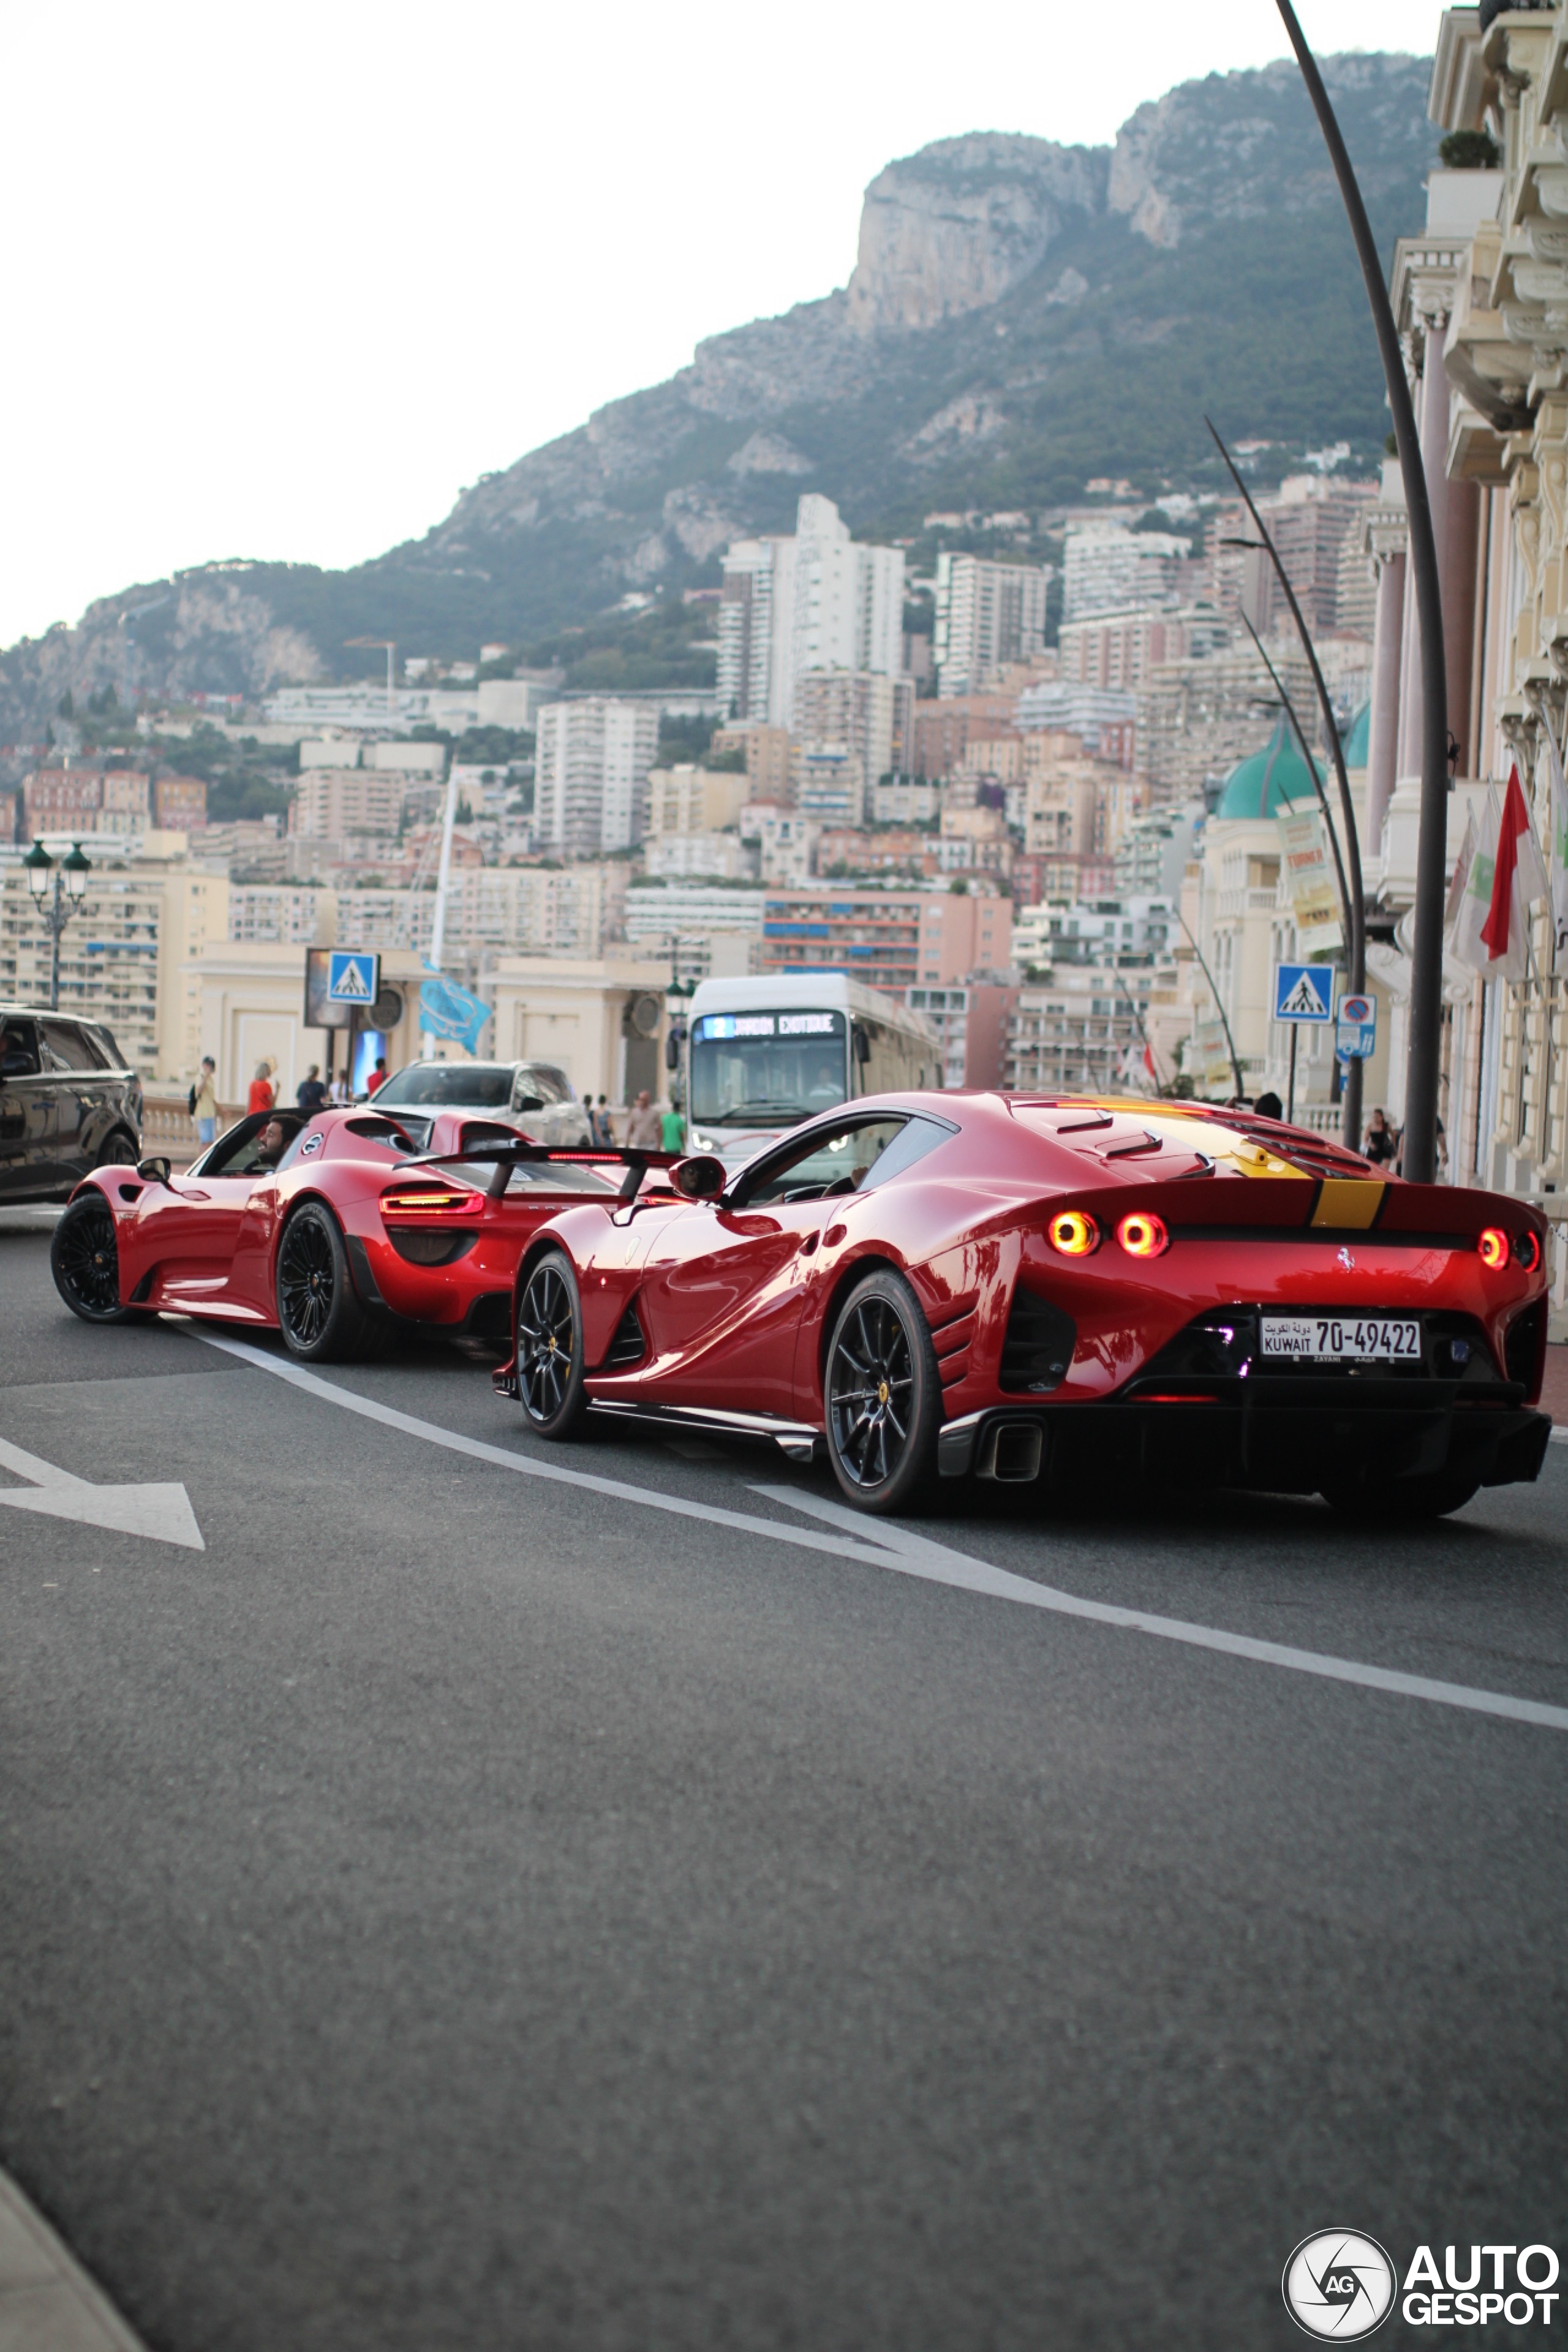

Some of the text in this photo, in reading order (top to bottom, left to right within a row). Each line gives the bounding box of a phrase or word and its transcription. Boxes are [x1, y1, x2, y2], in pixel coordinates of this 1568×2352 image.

[714, 1017, 726, 1037] 2
[1265, 1338, 1311, 1352] KUWAIT
[1316, 1322, 1418, 1354] 70-49422
